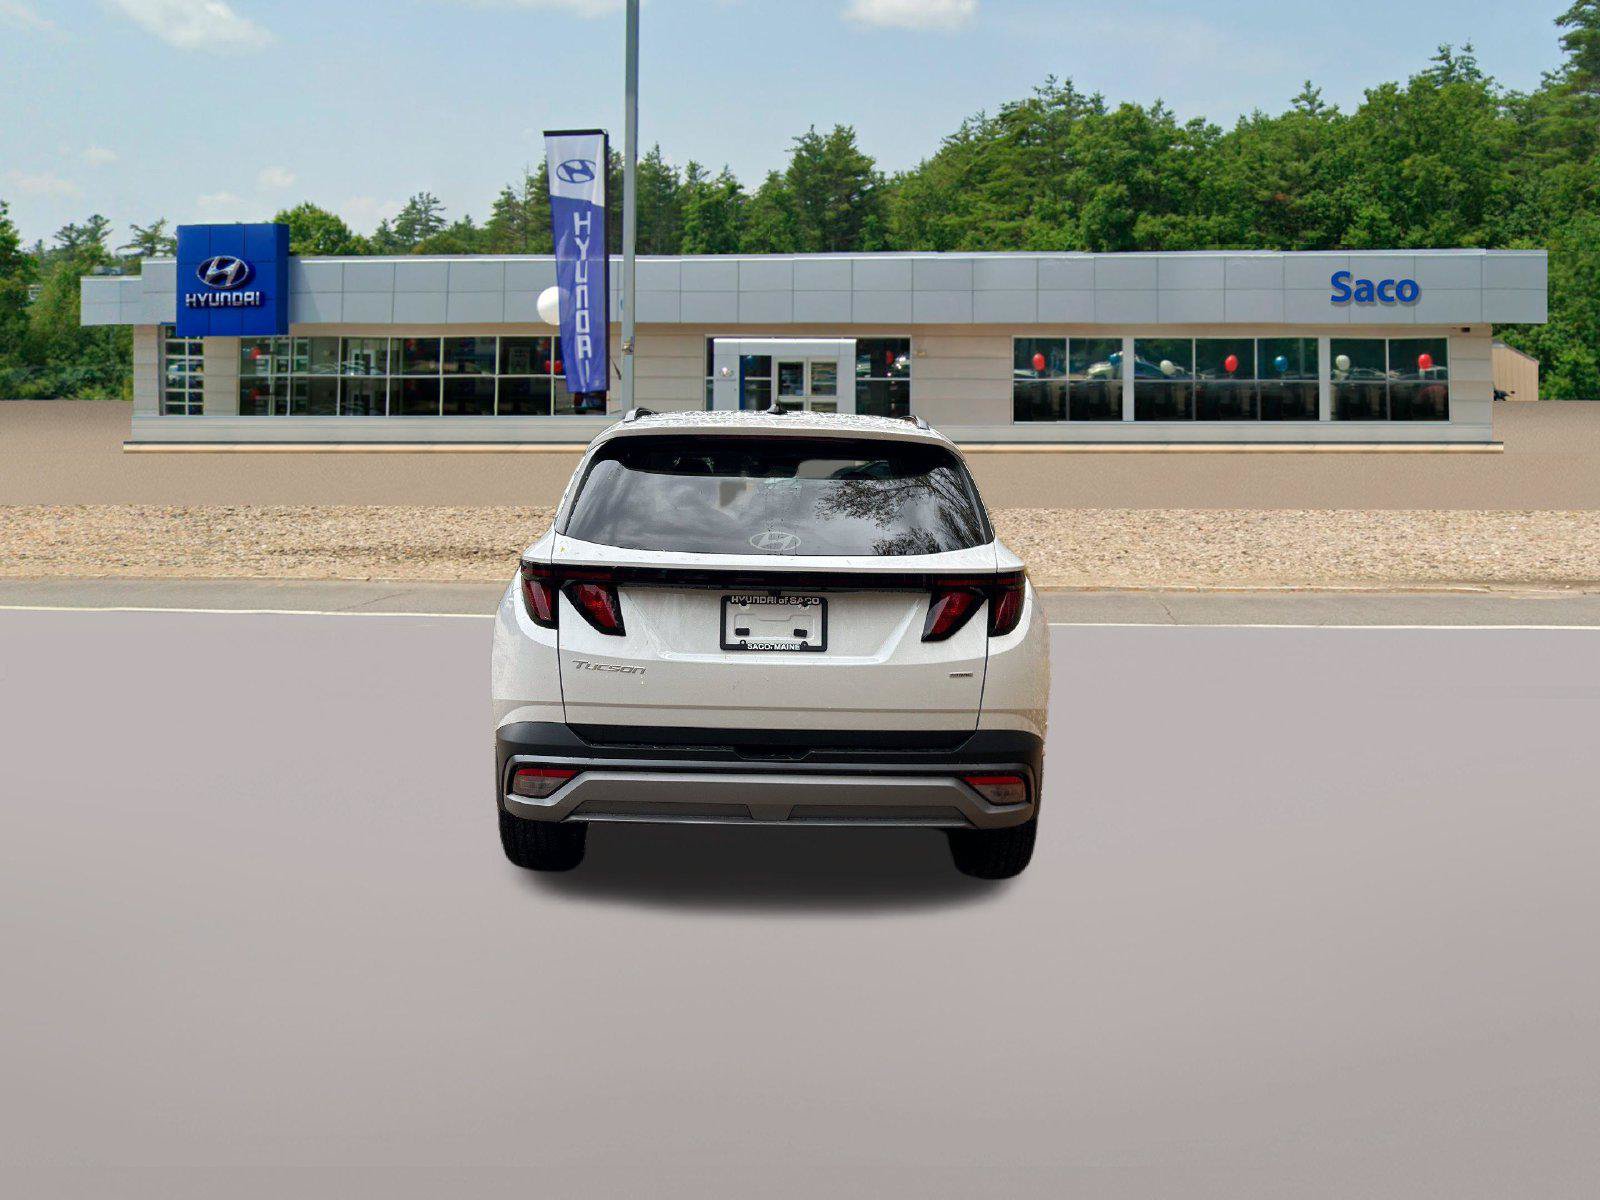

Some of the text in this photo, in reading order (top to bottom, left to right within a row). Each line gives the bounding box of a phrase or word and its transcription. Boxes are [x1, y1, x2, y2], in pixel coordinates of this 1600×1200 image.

[1330, 270, 1420, 303] Saco
[185, 291, 261, 307] HYUNDAI
[573, 210, 592, 384] HYUNDAI
[778, 596, 789, 605] of
[773, 643, 801, 651] MAINE
